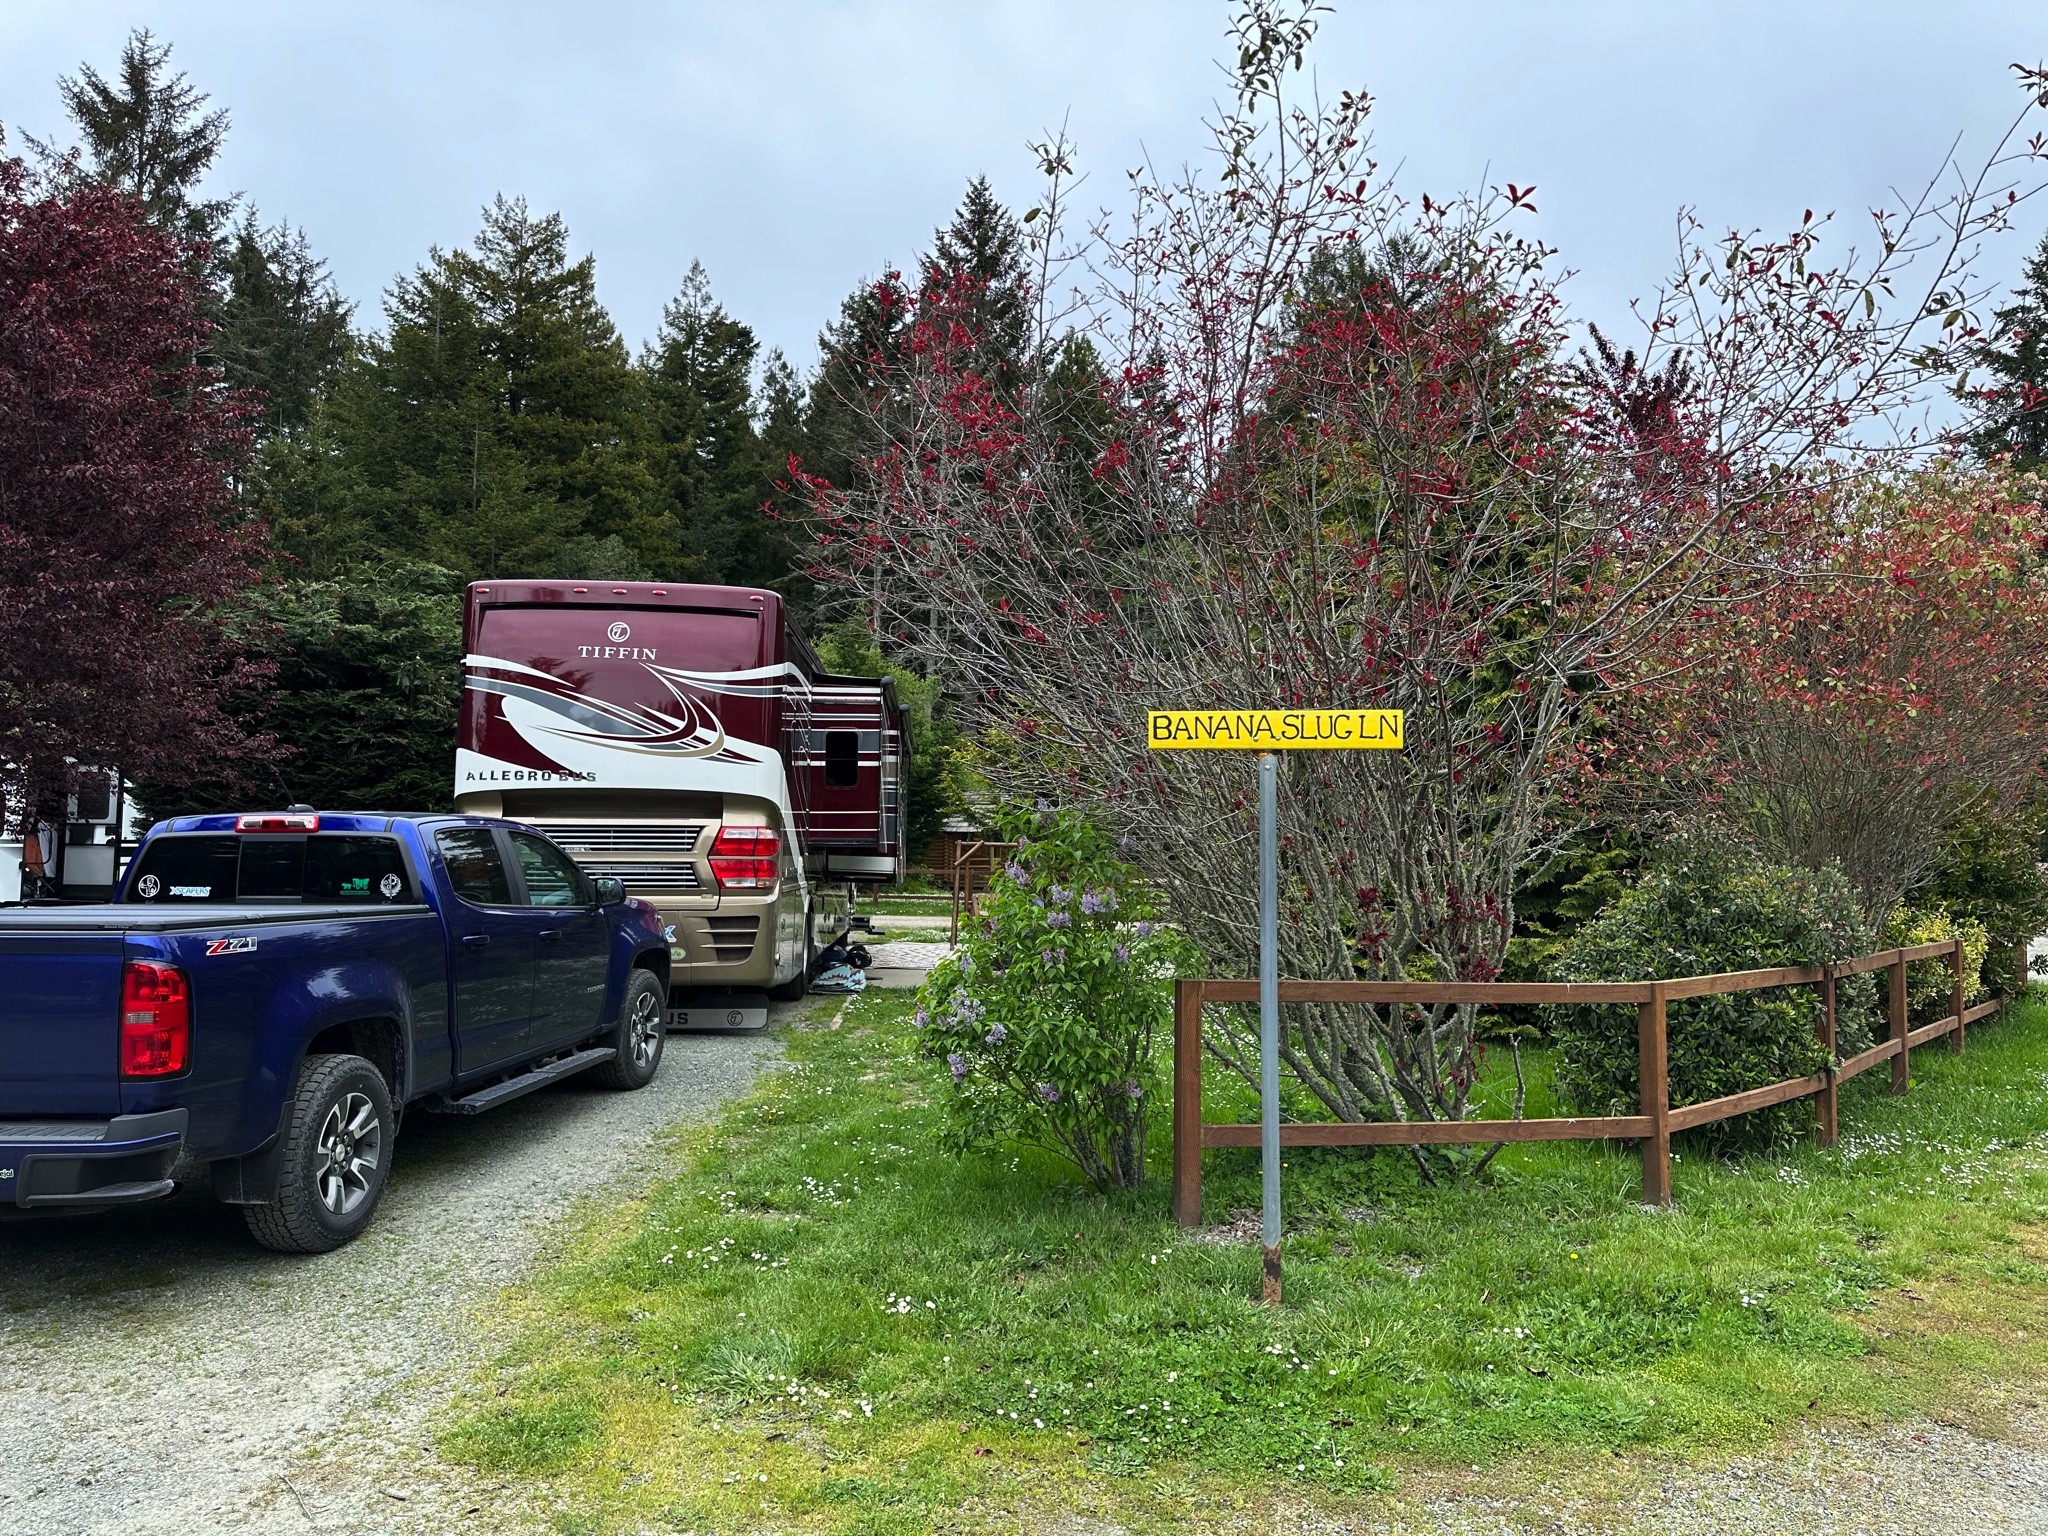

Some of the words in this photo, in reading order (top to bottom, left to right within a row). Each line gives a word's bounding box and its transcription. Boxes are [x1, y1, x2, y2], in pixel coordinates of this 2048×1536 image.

[577, 645, 658, 661] TIFFIN
[1152, 713, 1274, 740] BANANA
[1281, 714, 1352, 740] SLUG
[1358, 714, 1399, 739] LN
[465, 770, 553, 782] ALLEGRO
[558, 770, 597, 783] BUS
[205, 936, 258, 956] Z71
[665, 1012, 689, 1025] US
